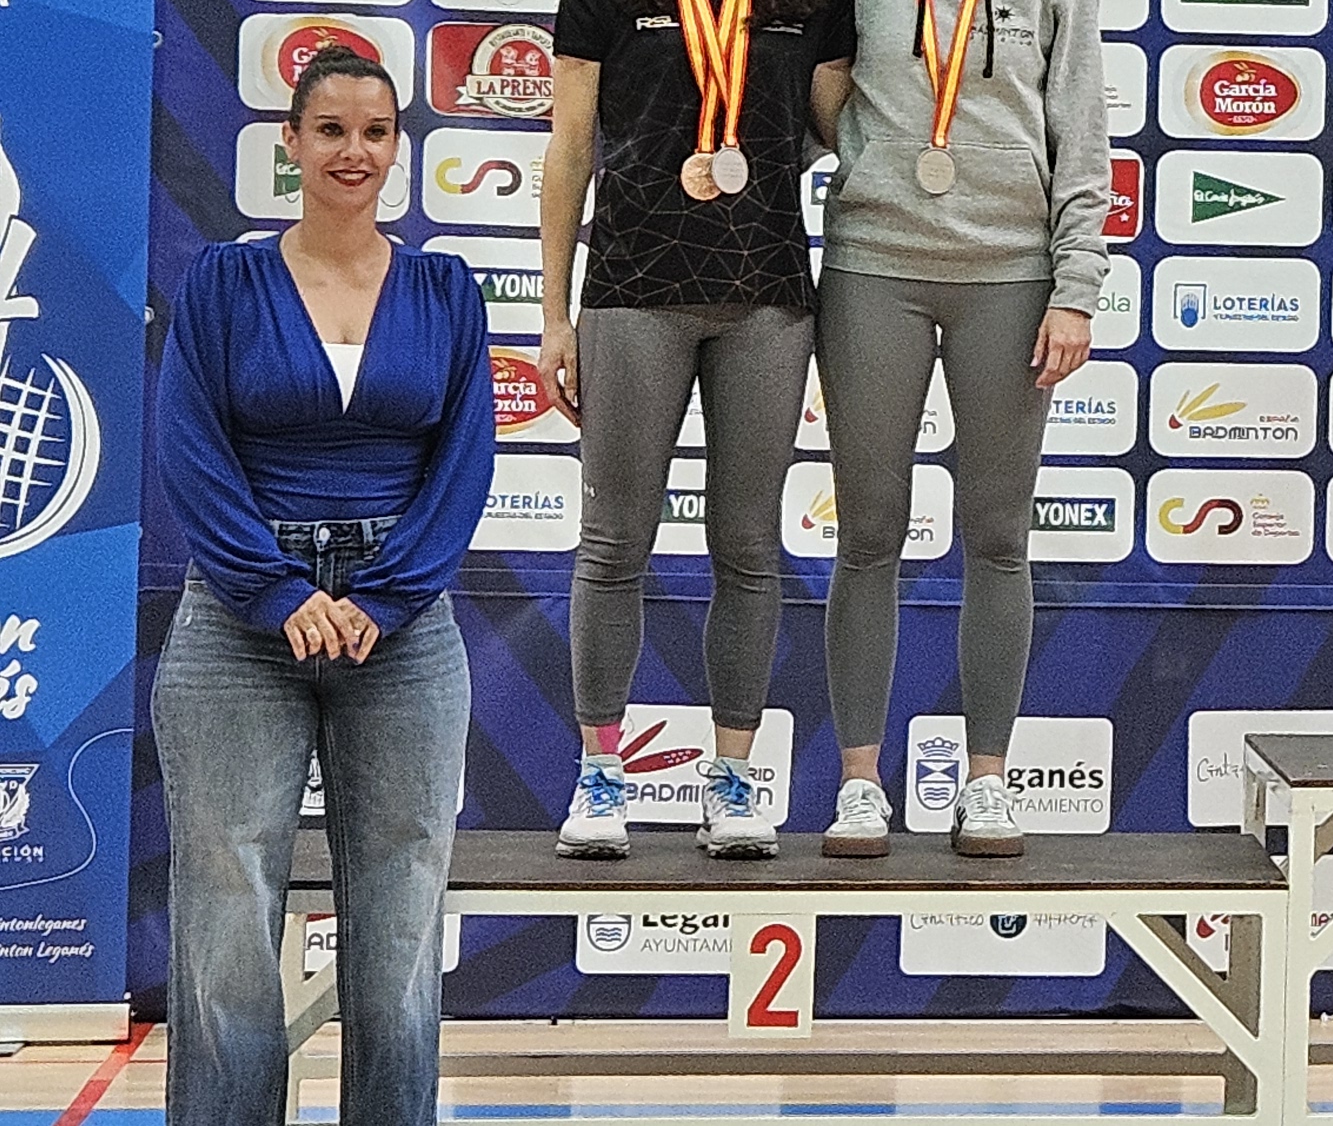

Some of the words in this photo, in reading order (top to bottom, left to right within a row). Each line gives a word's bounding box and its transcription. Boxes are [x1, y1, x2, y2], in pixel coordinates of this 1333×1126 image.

[500, 78, 552, 97] PRENS
[1213, 78, 1278, 97] García
[1213, 97, 1277, 114] Morón
[491, 273, 544, 297] YONE
[1212, 294, 1300, 312] LOTERÍAS
[1048, 396, 1117, 414] TERÍAS
[1188, 424, 1299, 442] BADMINTON
[484, 492, 565, 511] OTERÍAS
[1035, 502, 1108, 527] YONEX
[1006, 760, 1105, 794] ganés
[1010, 796, 1105, 813] NTAMIENTO
[640, 938, 732, 953] AYUNTAMI
[747, 923, 803, 1028] 2
